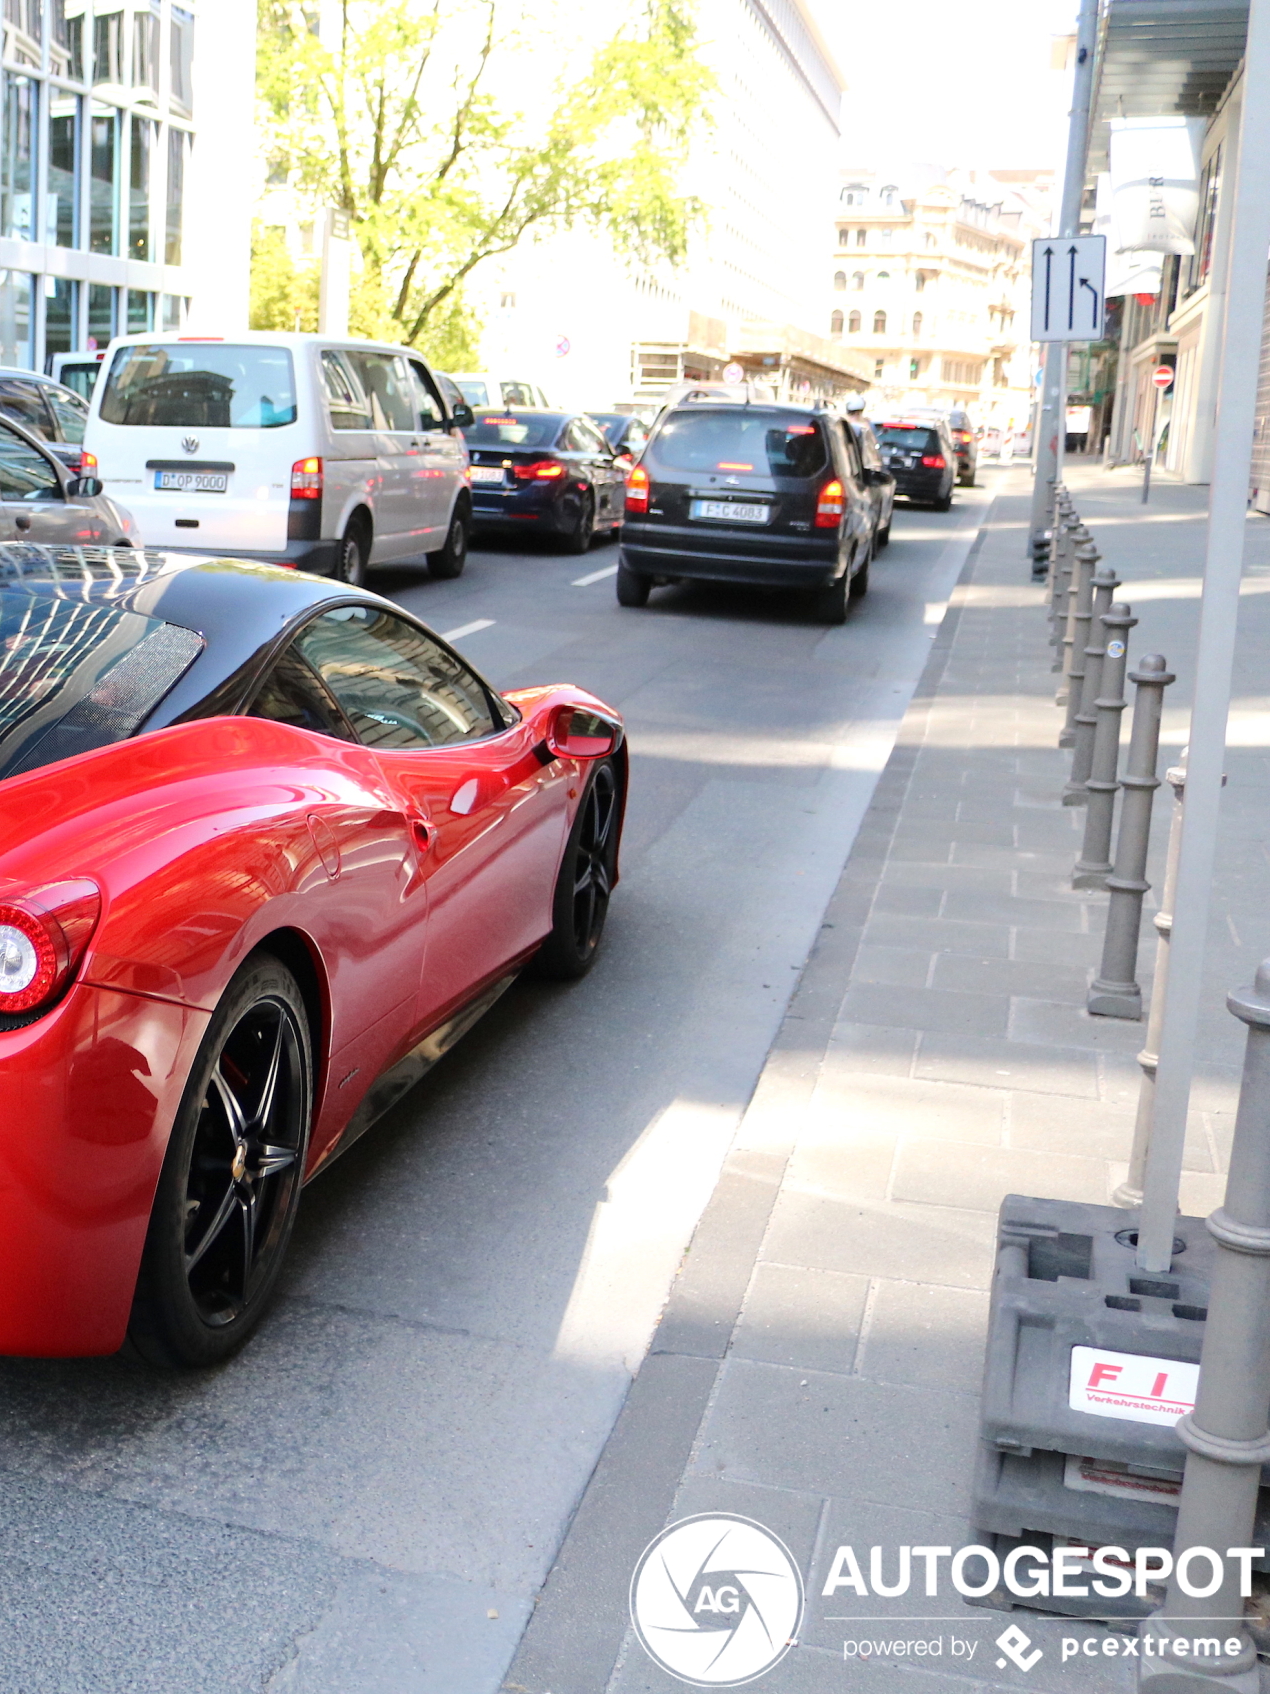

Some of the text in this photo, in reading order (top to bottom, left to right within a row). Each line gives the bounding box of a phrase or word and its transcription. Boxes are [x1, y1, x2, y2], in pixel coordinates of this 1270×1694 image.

[162, 474, 224, 489] D OP 9000
[732, 506, 763, 519] 4083
[1087, 1362, 1124, 1388] F
[1086, 1393, 1186, 1416] Verkehrstechnik
